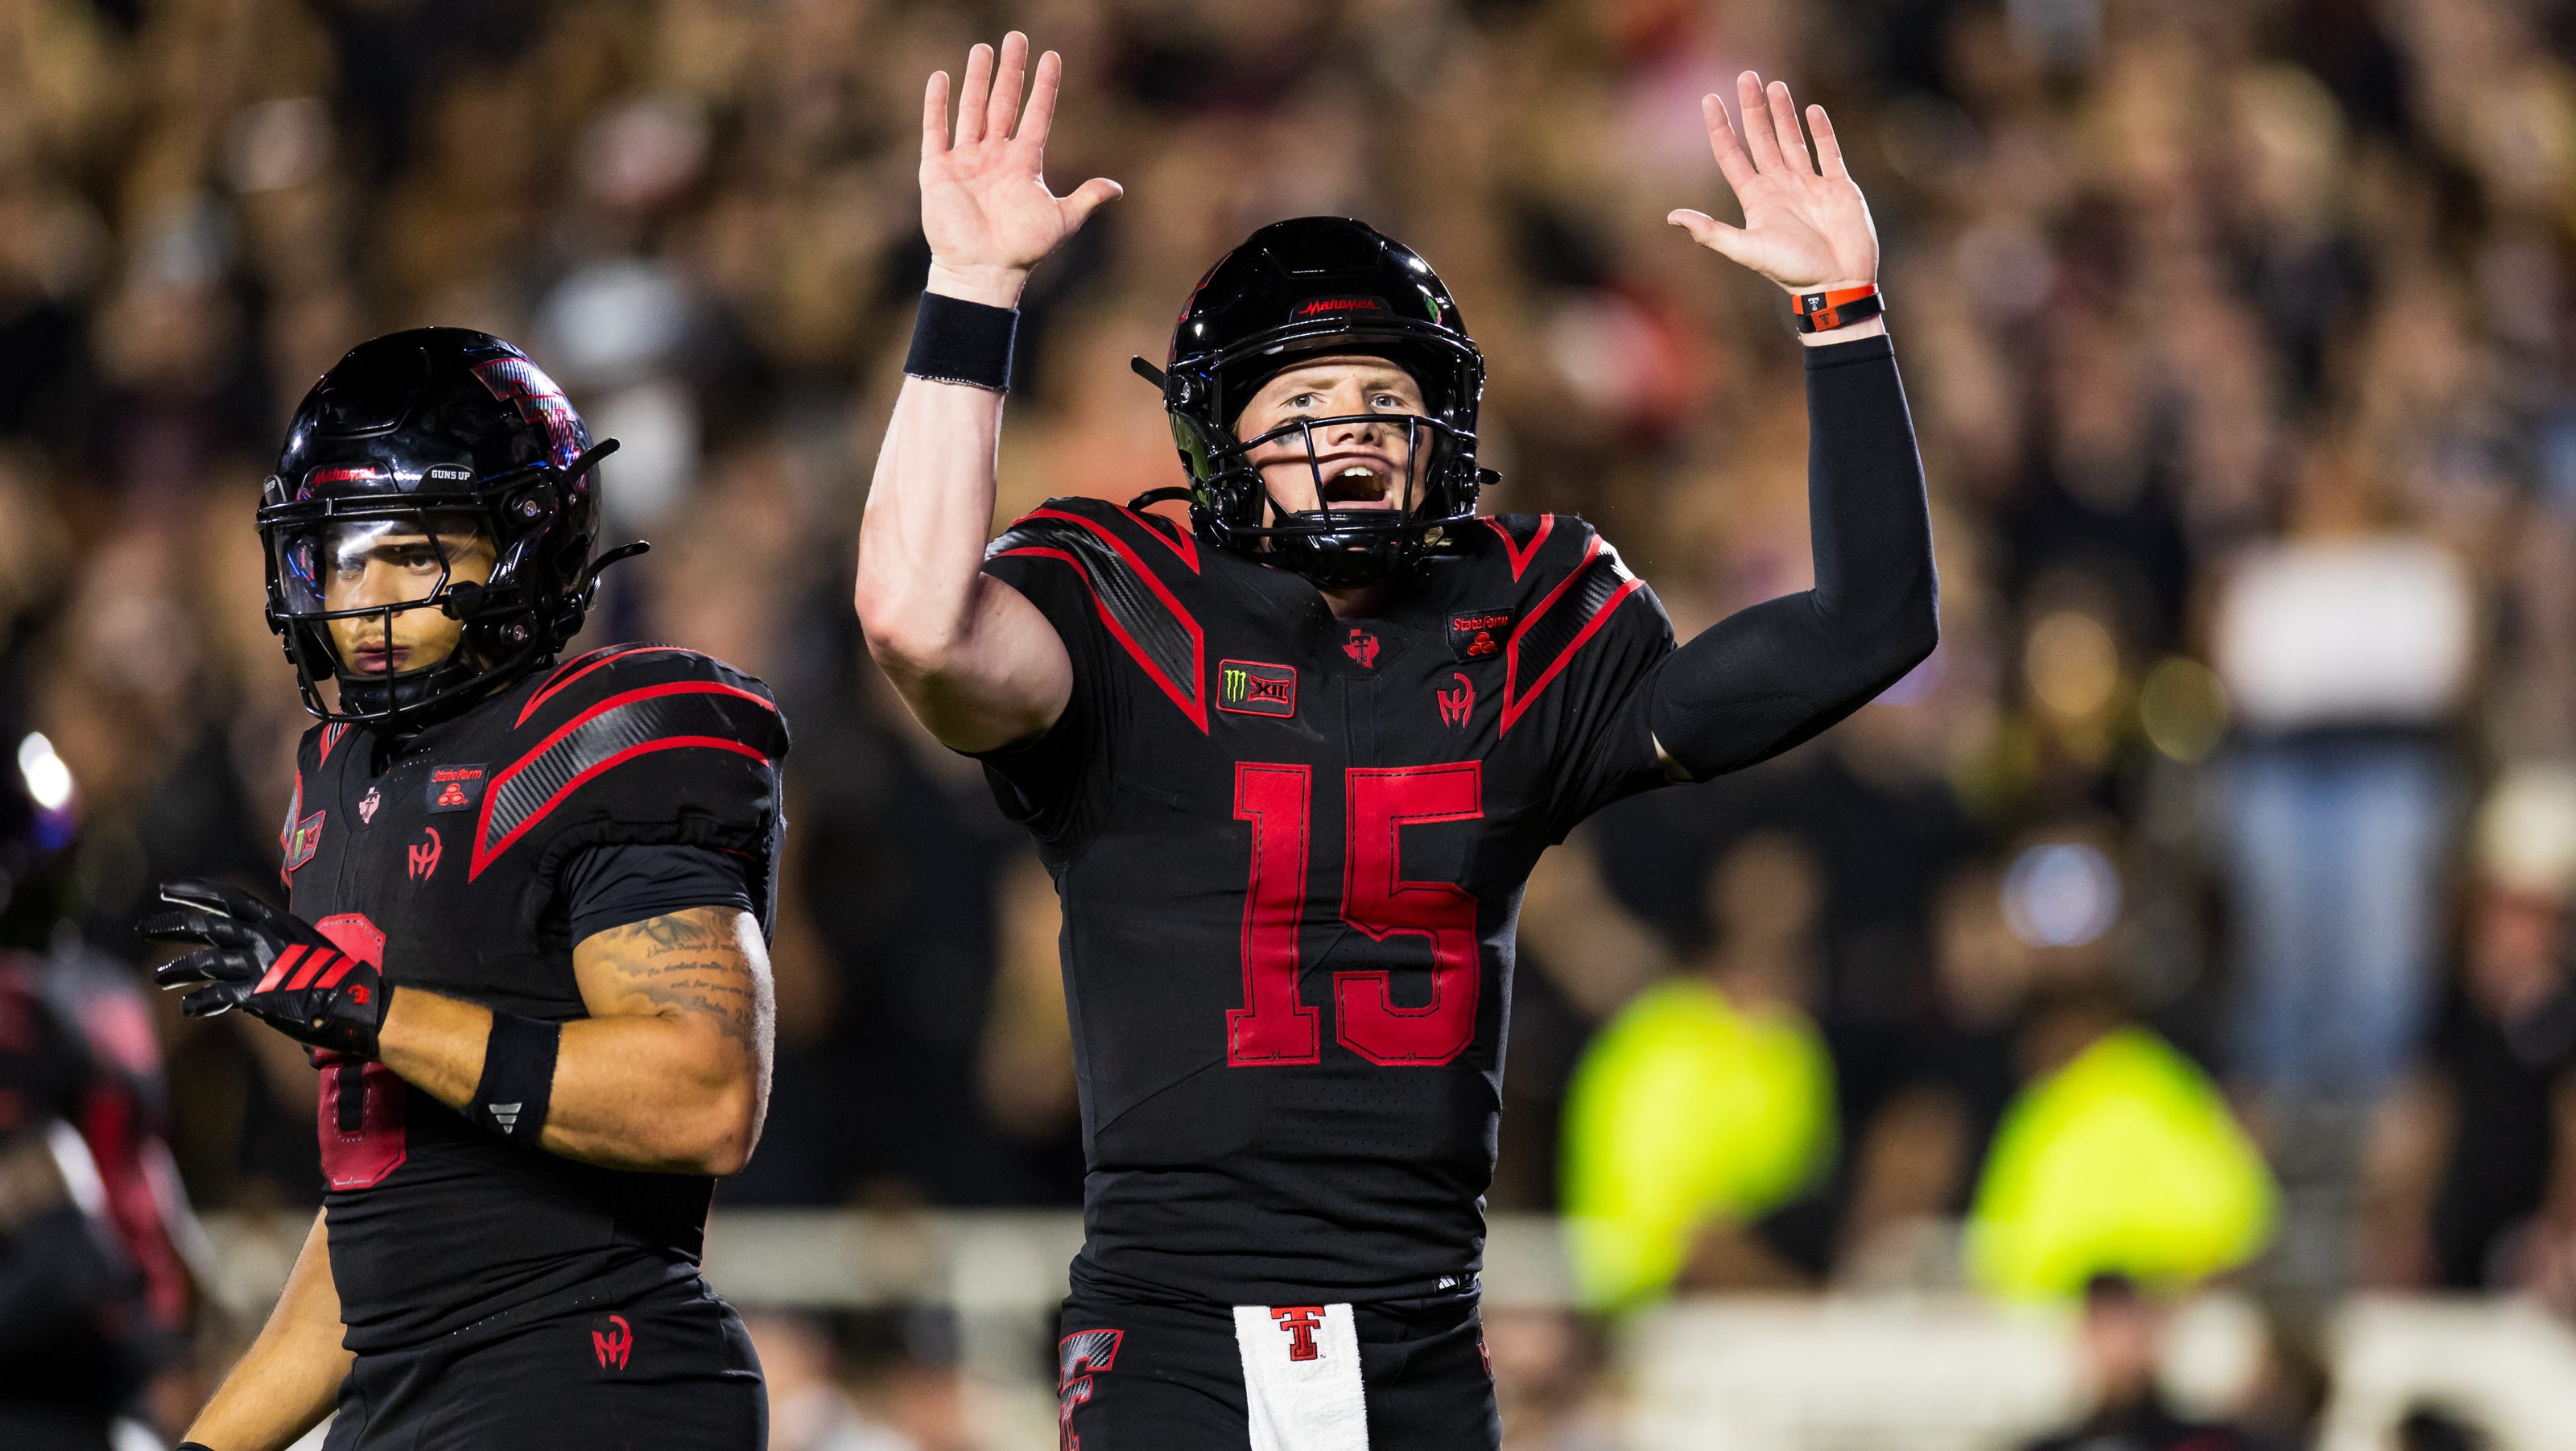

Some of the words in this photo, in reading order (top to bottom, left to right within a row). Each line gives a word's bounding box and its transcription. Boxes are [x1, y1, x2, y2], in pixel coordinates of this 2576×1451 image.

[431, 469, 457, 480] GUNS
[458, 471, 471, 481] UP
[1454, 617, 1483, 631] State
[1483, 615, 1509, 630] Farm
[457, 768, 482, 780] Farm
[1226, 761, 1484, 1068] 15
